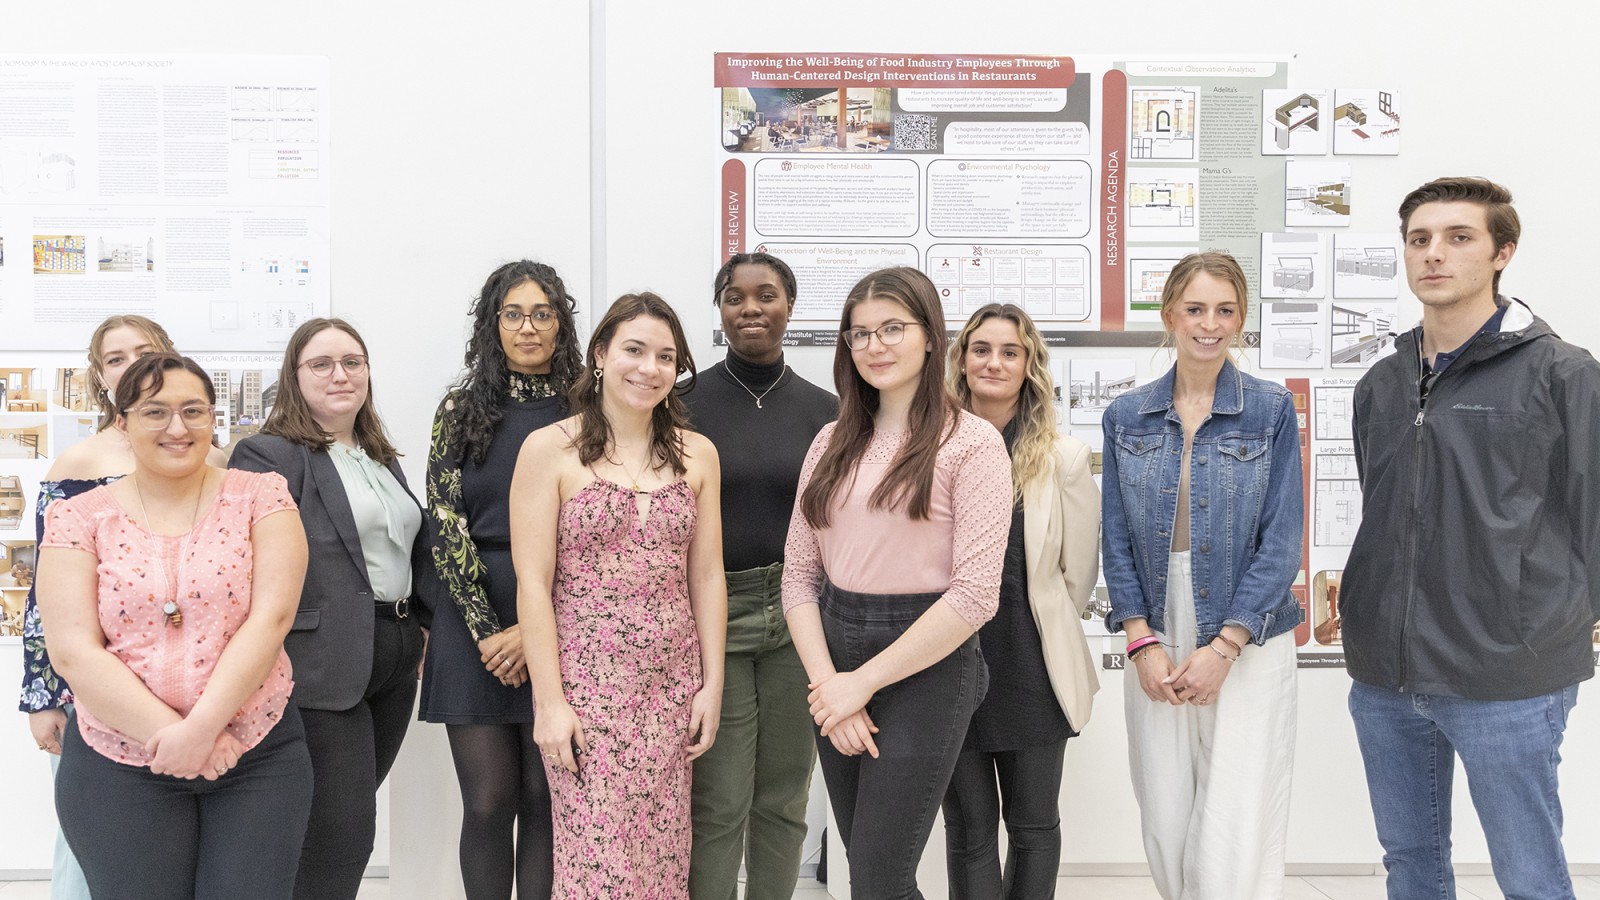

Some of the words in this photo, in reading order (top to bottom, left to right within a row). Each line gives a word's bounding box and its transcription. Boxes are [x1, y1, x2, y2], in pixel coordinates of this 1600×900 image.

[728, 57, 782, 68] Improving
[786, 57, 802, 66] the
[806, 57, 864, 68] Well-Being
[867, 57, 876, 67] of
[880, 58, 904, 67] Food
[908, 58, 952, 69] Industry
[956, 58, 1012, 69] Employees
[1016, 59, 1060, 70] Through
[1227, 66, 1256, 74] Analytics
[750, 71, 840, 81] Human-Centered
[844, 71, 880, 82] Design
[884, 71, 955, 81] Interventions
[958, 71, 968, 81] in
[972, 71, 1036, 81] Restaurants
[930, 116, 937, 127] ME
[793, 163, 825, 171] Employee
[1015, 163, 1051, 172] Psychology
[1108, 150, 1118, 203] AGENDA
[729, 190, 739, 235] REVIEW
[1107, 206, 1117, 266] RESEARCH
[818, 248, 853, 256] Well-Being
[881, 248, 906, 256] Physical
[1021, 248, 1043, 256] Design
[1111, 655, 1124, 668] R
